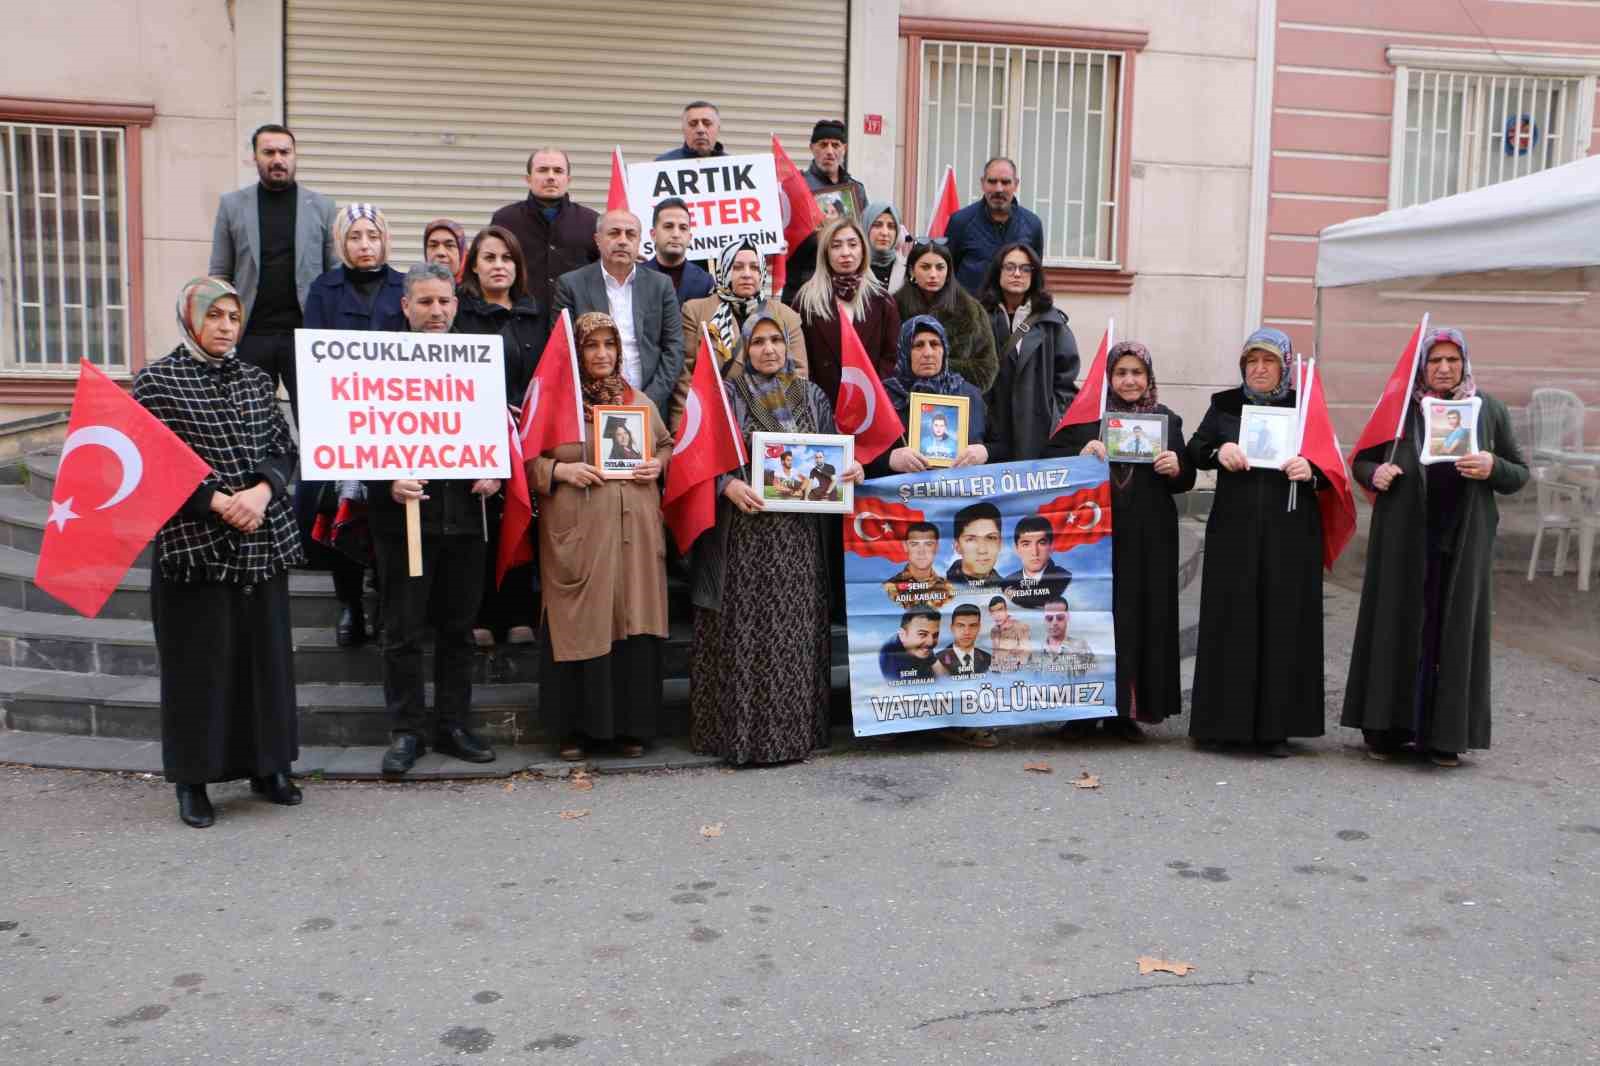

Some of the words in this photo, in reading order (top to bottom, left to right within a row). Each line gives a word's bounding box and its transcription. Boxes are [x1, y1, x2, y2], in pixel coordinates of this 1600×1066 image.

[653, 164, 757, 197] ARTIK
[311, 340, 492, 363] ÇOCUKLARIMIZ
[330, 371, 476, 402] KİMSENİN
[348, 405, 462, 435] PİYONU
[313, 444, 498, 470] OLMAYACAK
[898, 474, 996, 503] ŞEHİTLER
[1000, 467, 1070, 496] ÖLMEZ
[870, 690, 954, 722] VATAN
[960, 681, 1105, 716] BÖLÜNMEZ
